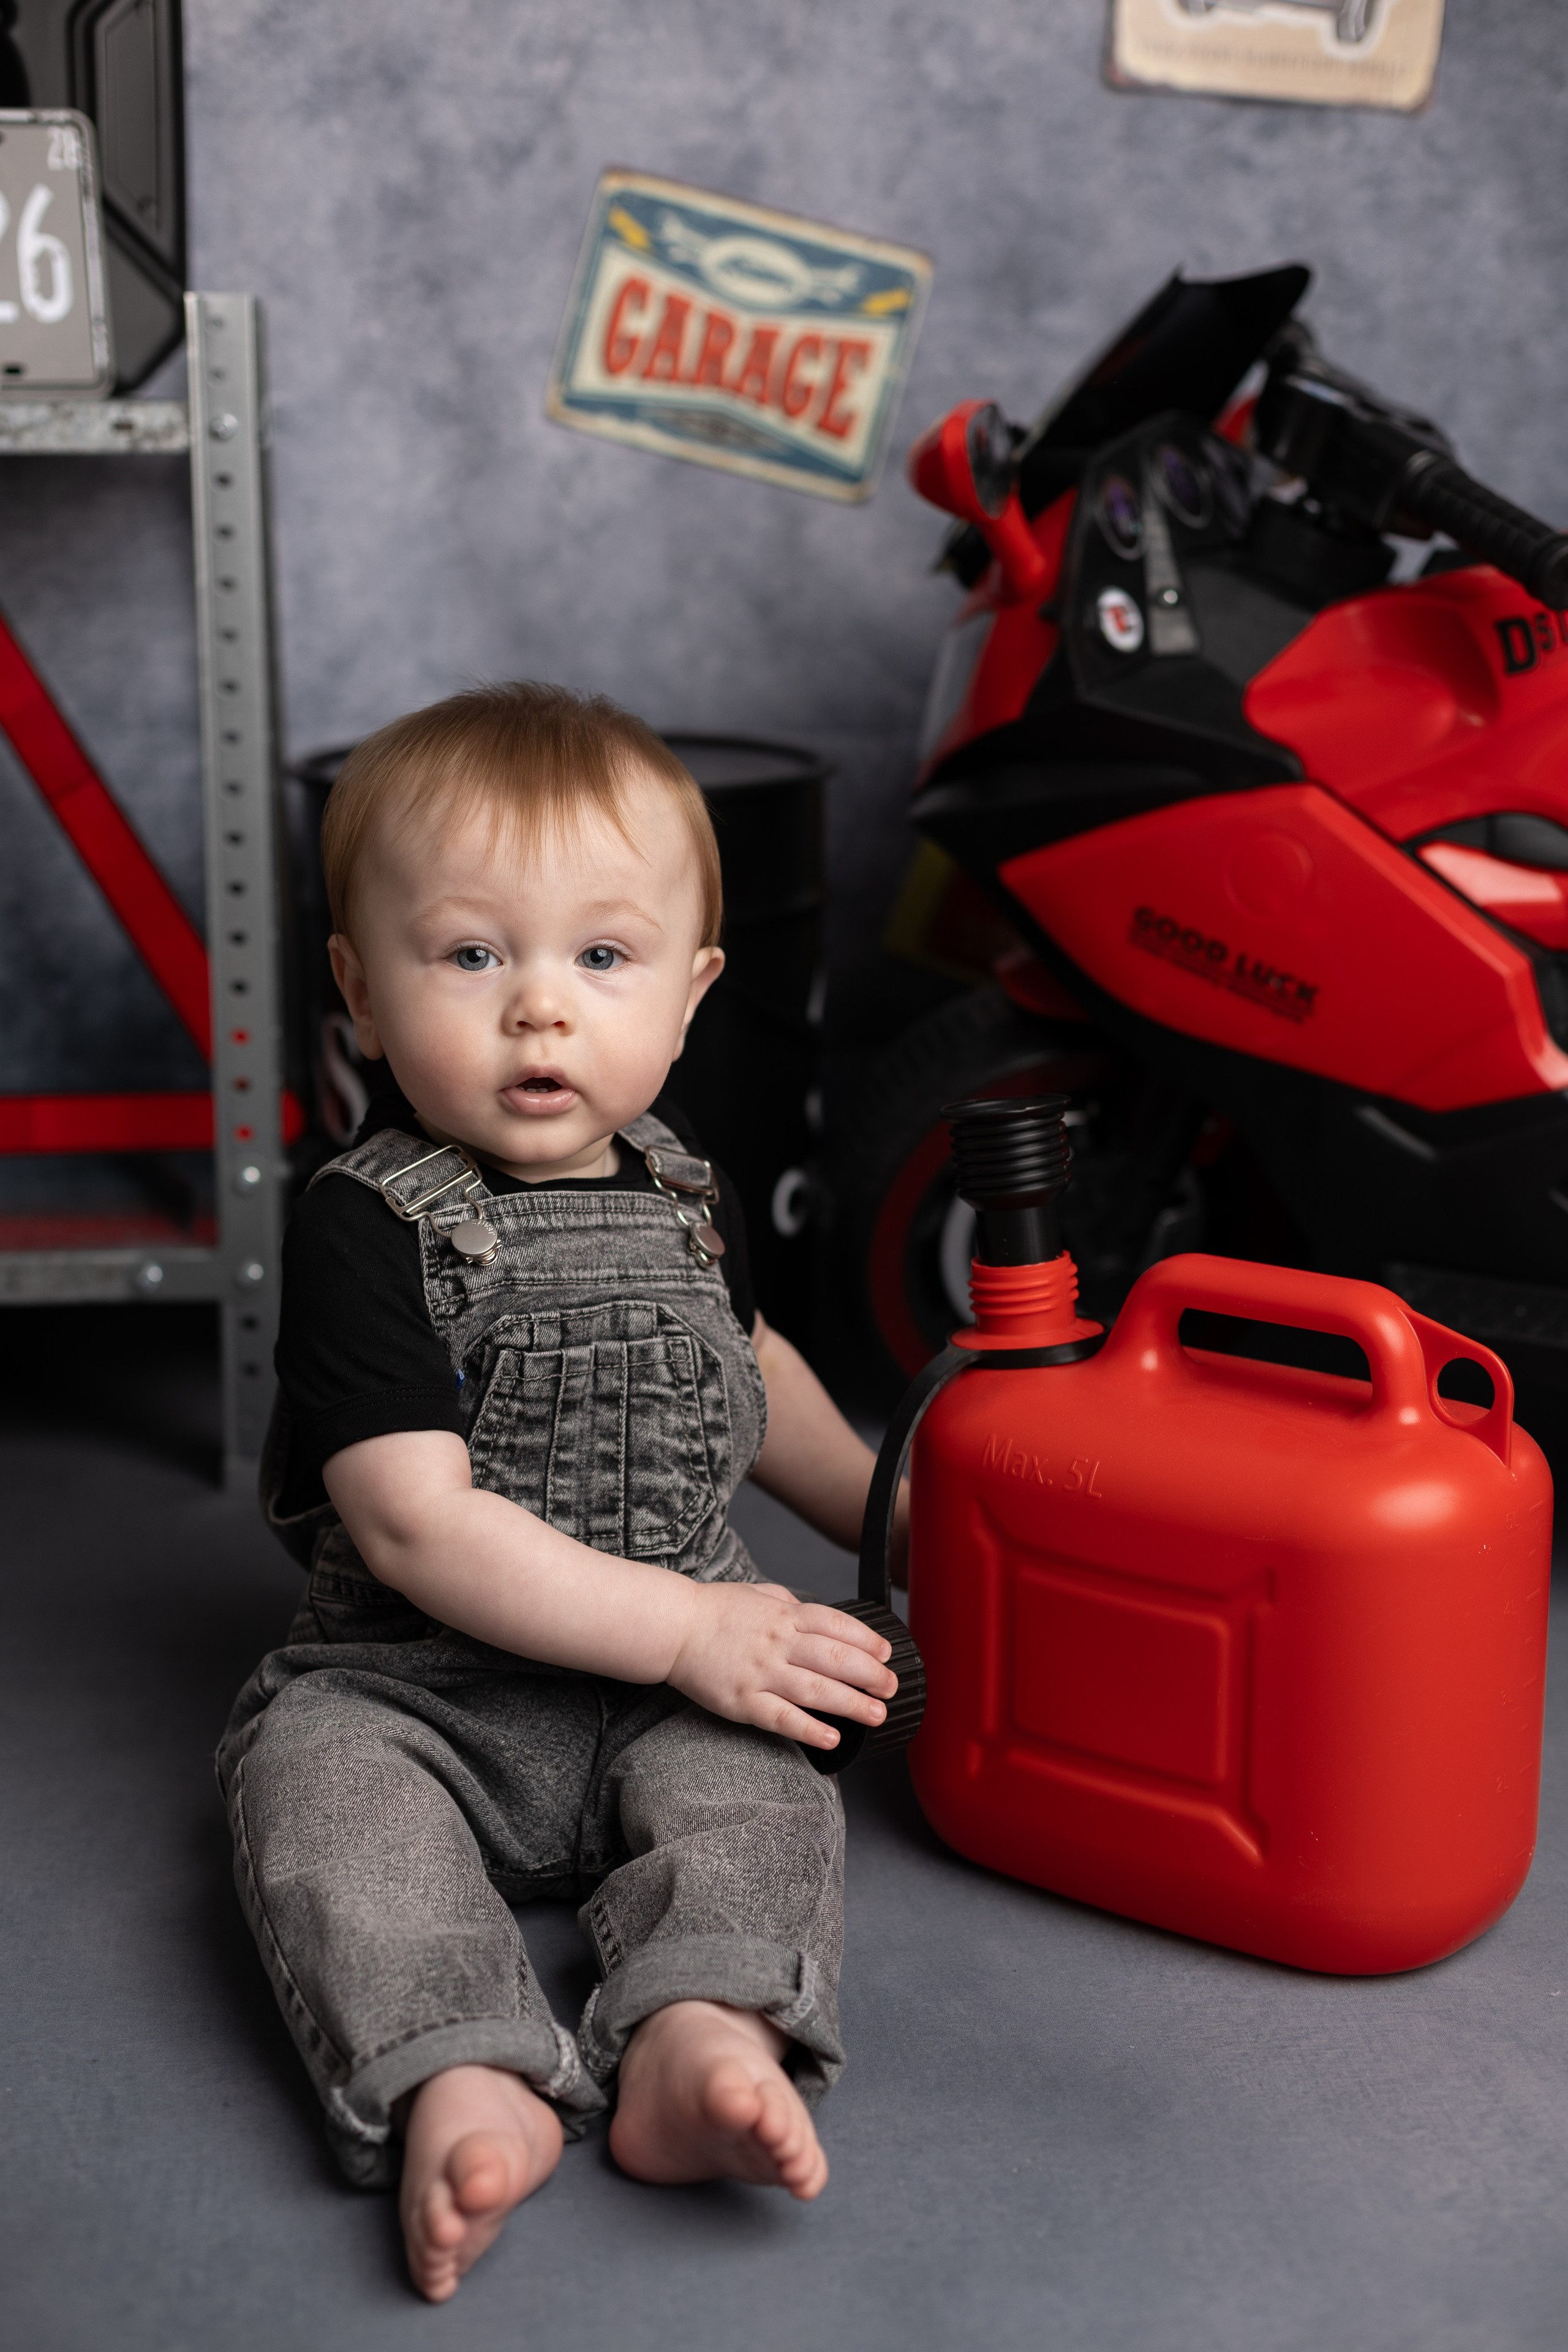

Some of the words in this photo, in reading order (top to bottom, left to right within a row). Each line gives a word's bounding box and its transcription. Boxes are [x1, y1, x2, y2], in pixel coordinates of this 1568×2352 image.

[600, 274, 875, 442] GARAGE
[1133, 905, 1229, 963] GOOD
[1234, 952, 1319, 1008] LUCK
[982, 1434, 1052, 1487] Max.
[1064, 1456, 1102, 1498] 5L
[1506, 1511, 1520, 1530] 5L
[1496, 1774, 1510, 1794] 2L
